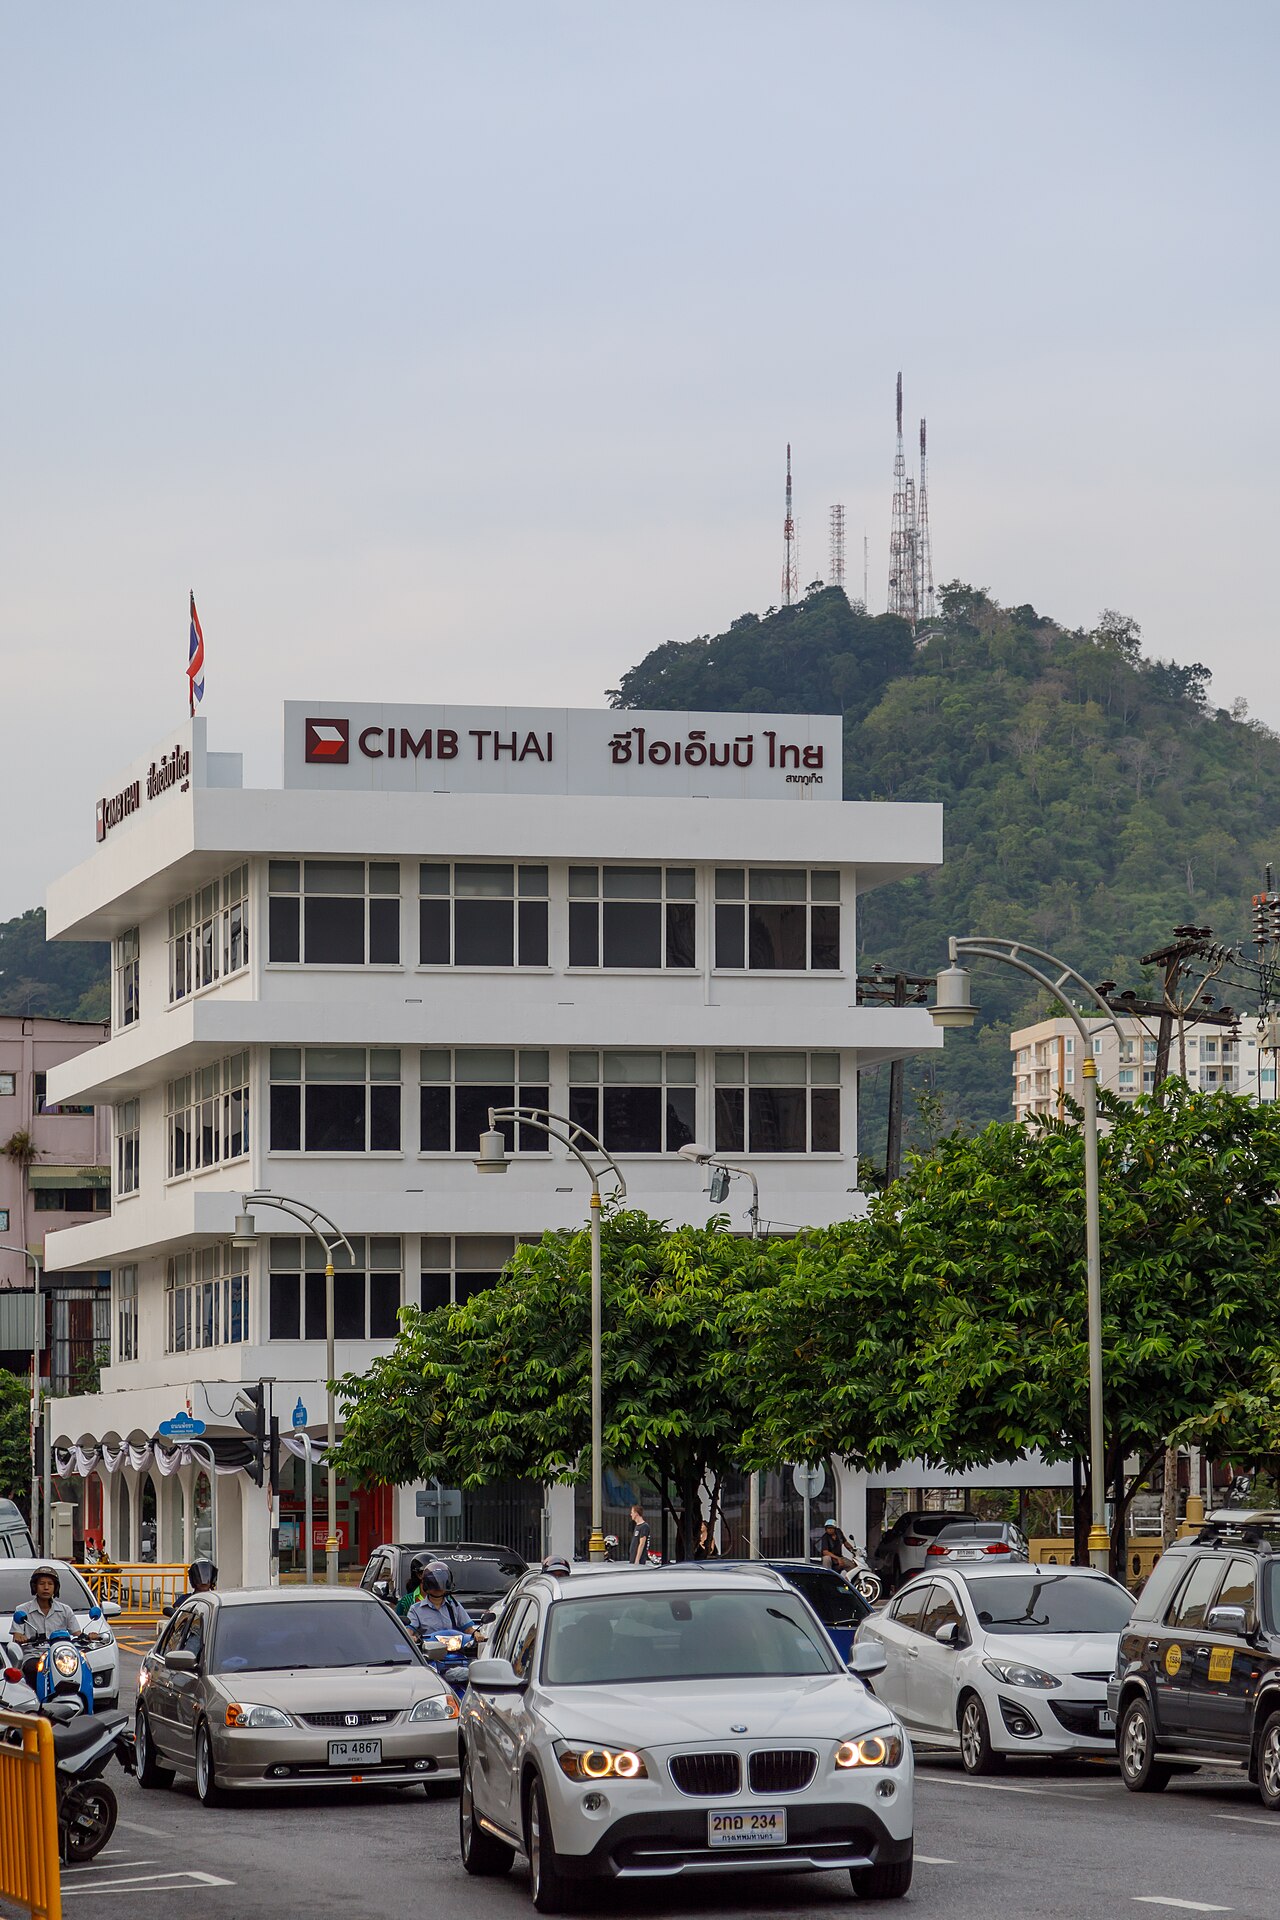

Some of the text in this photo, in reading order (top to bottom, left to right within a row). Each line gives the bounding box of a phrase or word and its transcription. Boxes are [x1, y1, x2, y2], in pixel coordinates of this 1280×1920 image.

[358, 726, 553, 762] CIMB THAI
[608, 727, 823, 768] ซีไอเอ็มบี ไทย
[351, 1742, 379, 1754] 4867
[750, 1814, 777, 1829] 234
